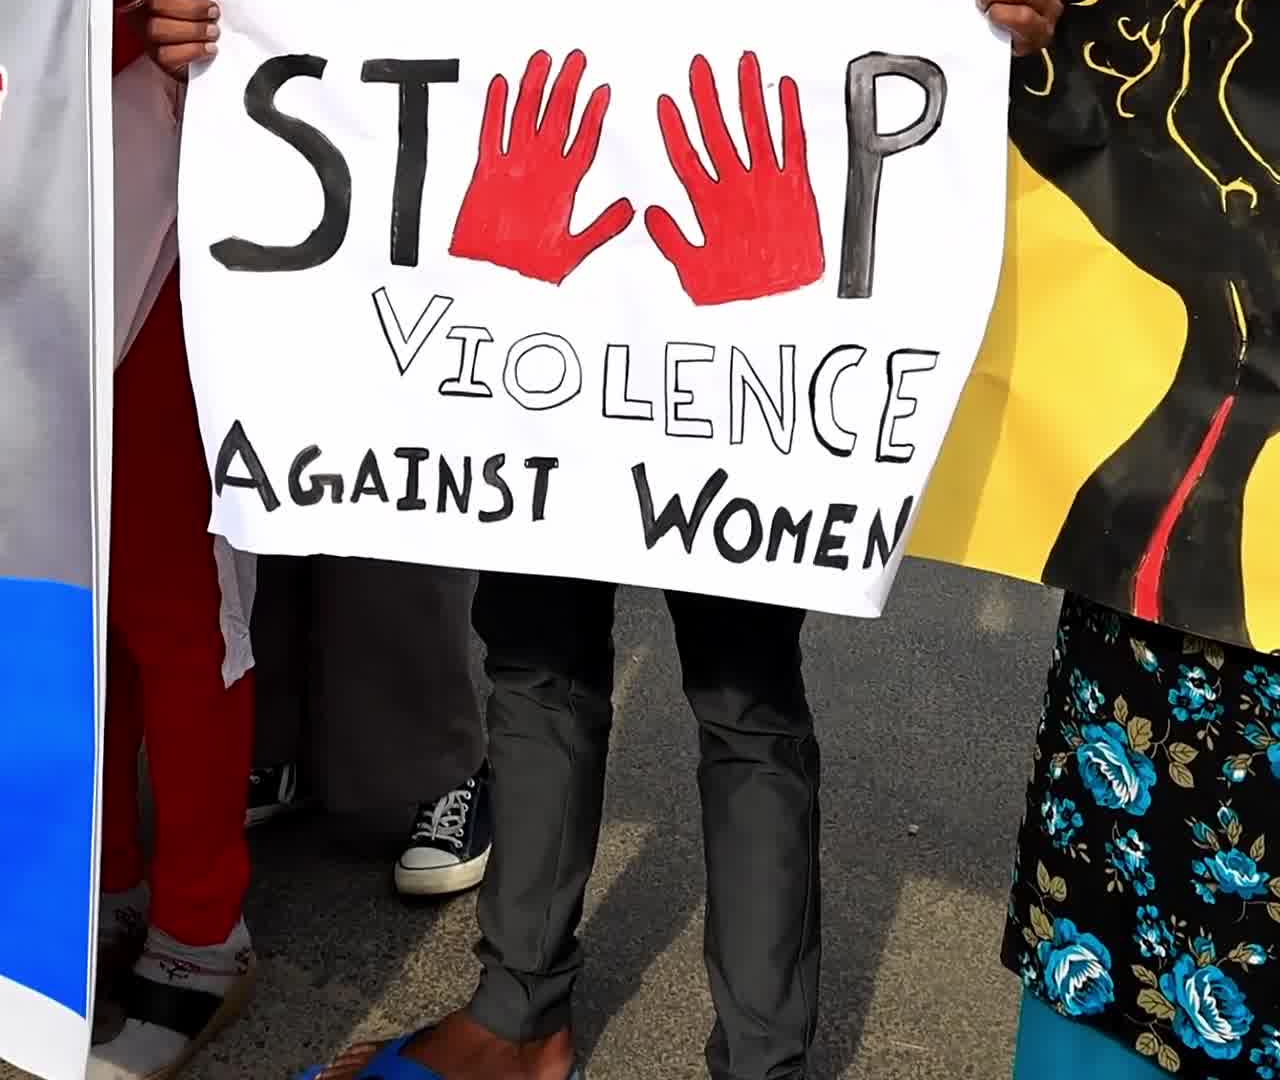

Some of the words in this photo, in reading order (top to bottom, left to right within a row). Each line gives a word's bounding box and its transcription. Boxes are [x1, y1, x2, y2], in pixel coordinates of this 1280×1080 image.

[371, 286, 940, 463] VIOLENCE
[214, 418, 561, 524] AGAINST
[631, 461, 916, 573] WOMEN
